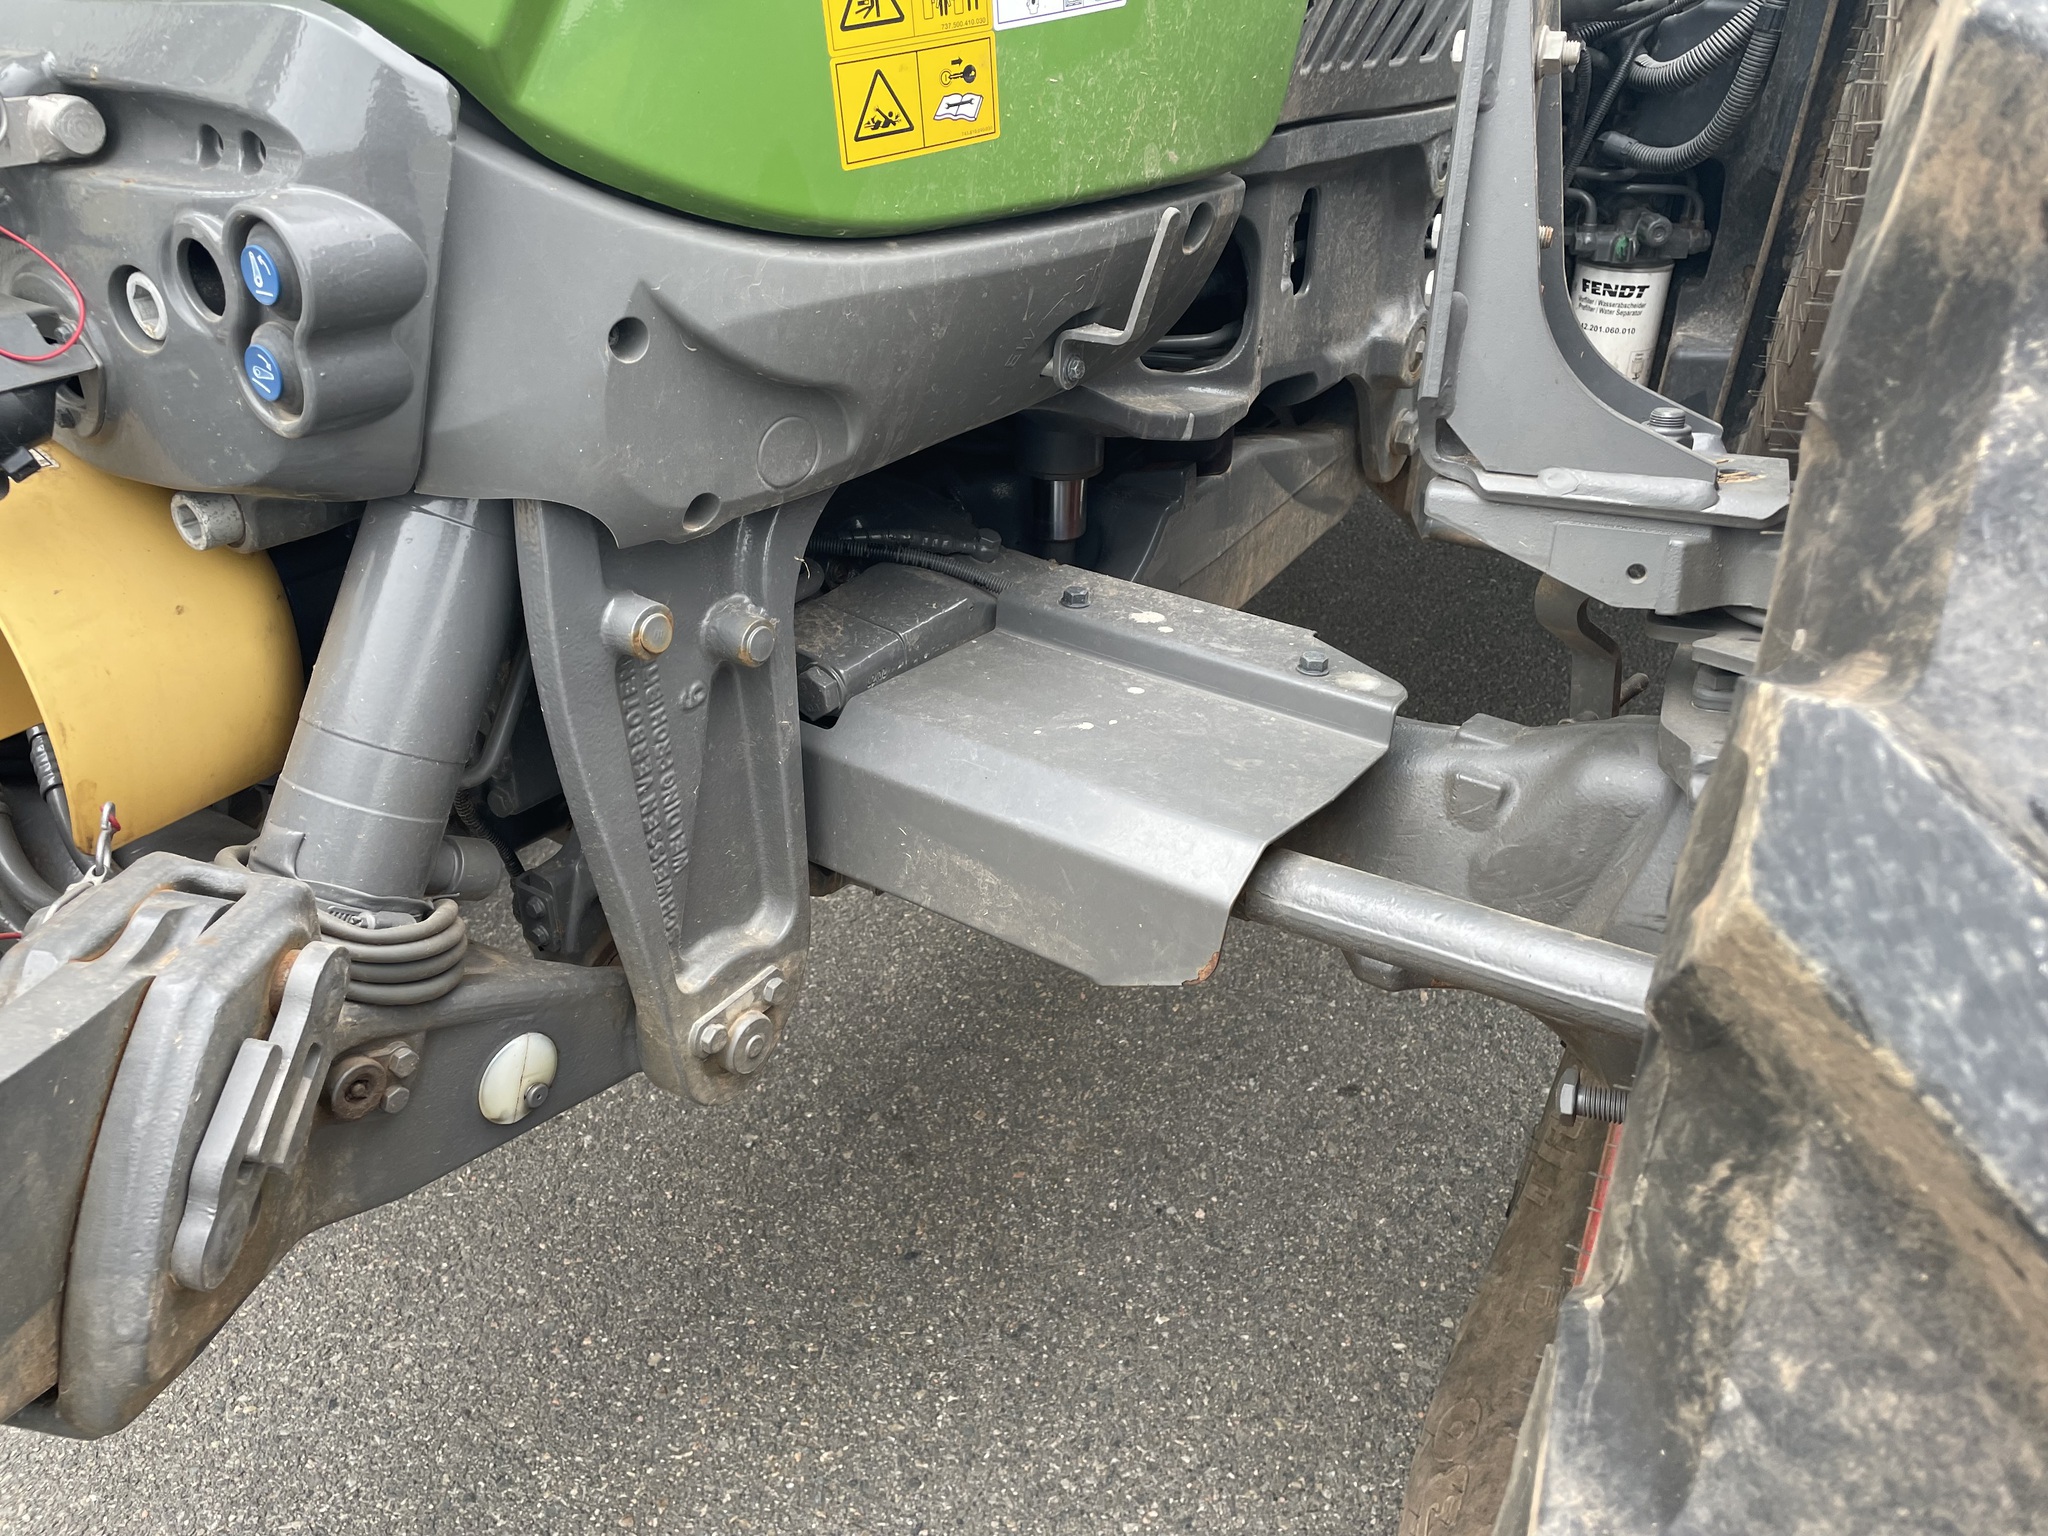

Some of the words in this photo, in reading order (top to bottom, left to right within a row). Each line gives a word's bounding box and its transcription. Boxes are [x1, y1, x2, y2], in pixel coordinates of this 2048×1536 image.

[941, 17, 986, 30] 737.500.410.030
[1582, 278, 1650, 298] FENDT
[1598, 299, 1646, 309] Wasserabscheider
[1599, 308, 1615, 316] Water
[1615, 309, 1643, 317] Separator
[619, 658, 653, 797] VERBOTEN
[660, 768, 689, 874] WELDING
[638, 792, 681, 945] SCHWEISSEN
